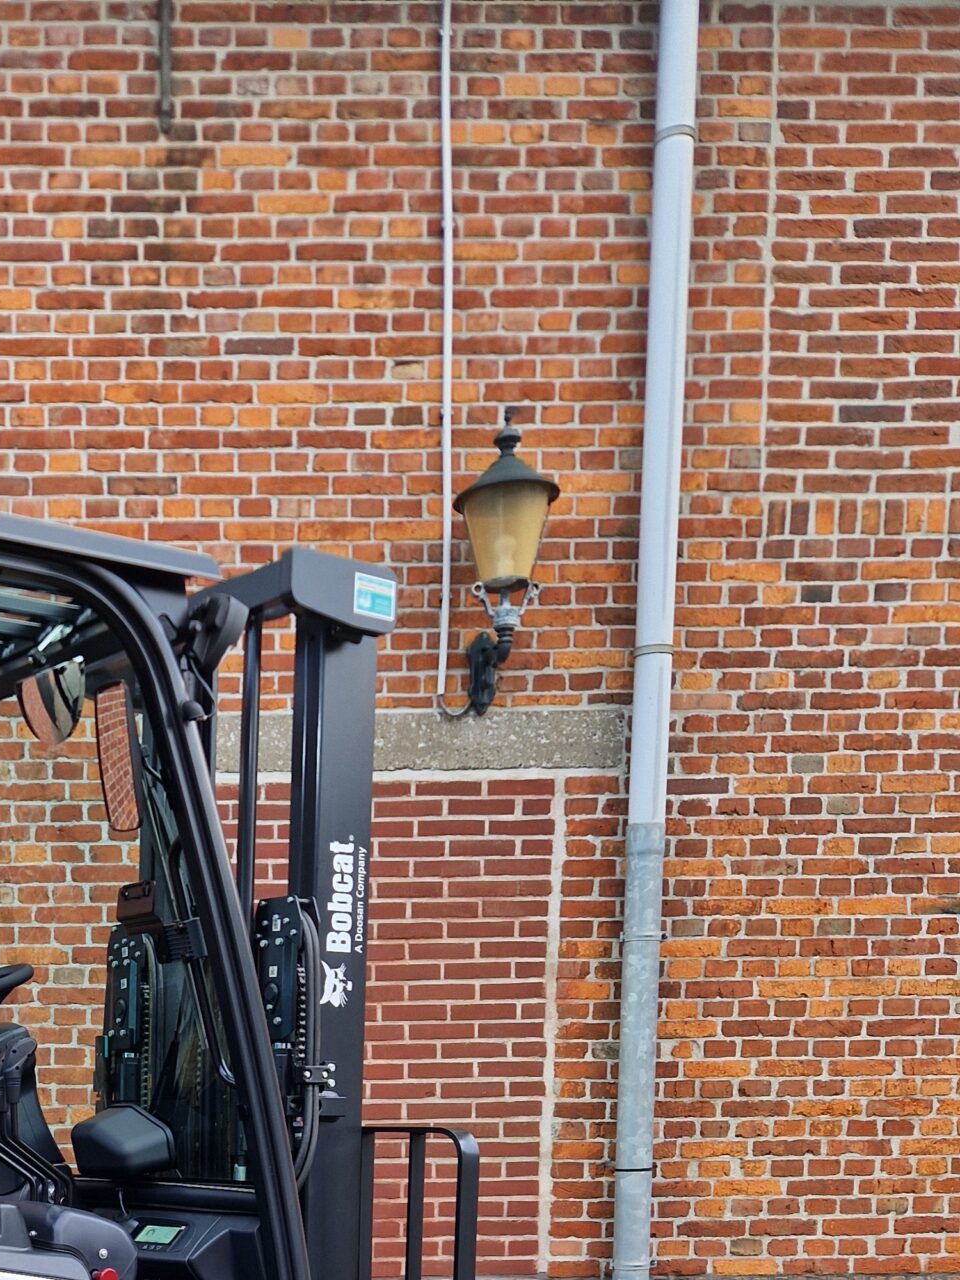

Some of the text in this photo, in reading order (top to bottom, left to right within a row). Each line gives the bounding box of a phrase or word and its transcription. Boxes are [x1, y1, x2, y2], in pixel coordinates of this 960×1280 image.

[326, 840, 355, 953] Bobcat
[354, 846, 368, 954] A Doosan Company
